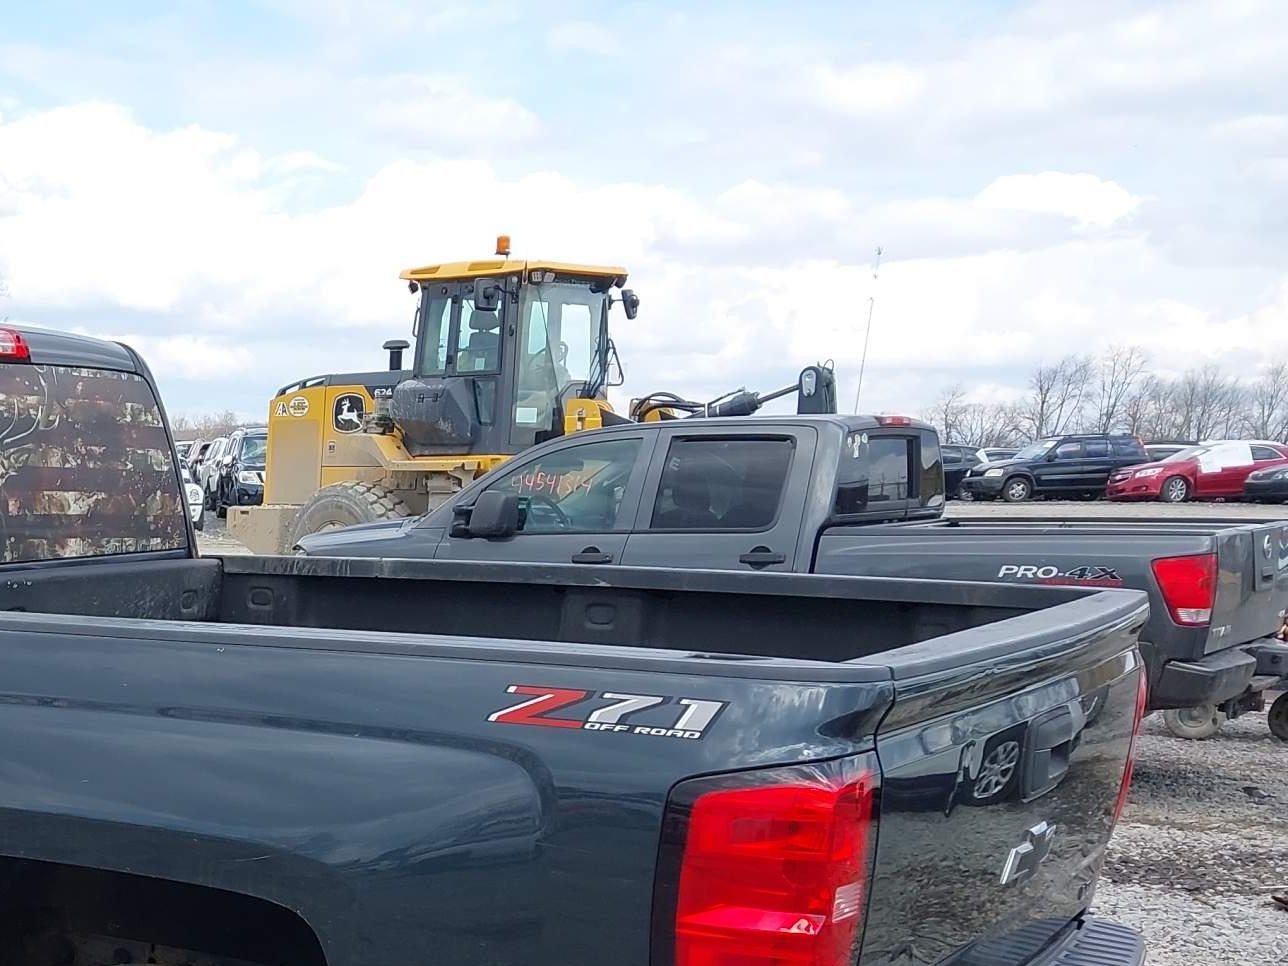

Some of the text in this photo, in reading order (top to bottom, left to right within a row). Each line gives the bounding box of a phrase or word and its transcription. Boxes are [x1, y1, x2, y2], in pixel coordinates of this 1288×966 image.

[997, 564, 1124, 581] PRO-4X
[487, 684, 726, 731] Z71
[583, 722, 701, 739] OFF ROAD
